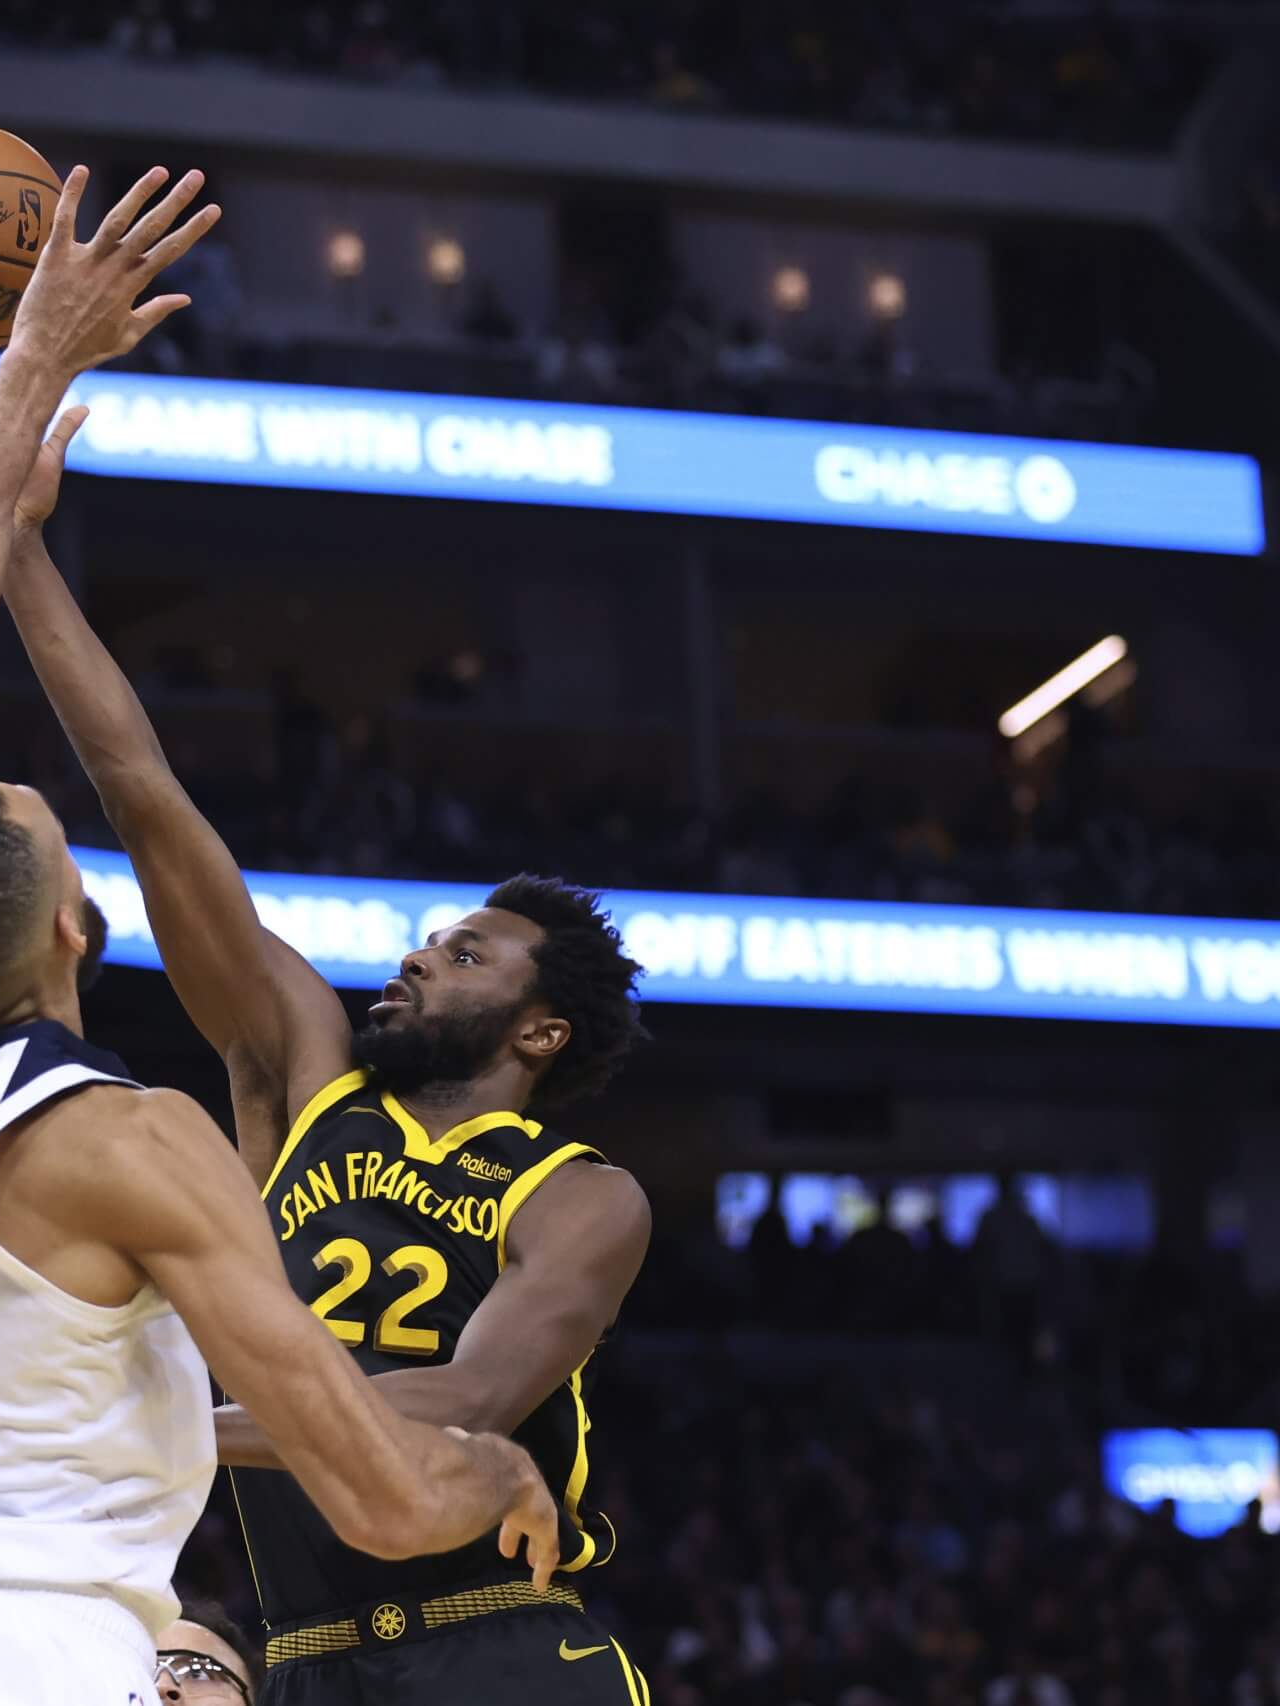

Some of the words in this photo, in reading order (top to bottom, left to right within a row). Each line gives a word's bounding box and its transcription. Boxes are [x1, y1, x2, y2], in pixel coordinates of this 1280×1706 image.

[83, 392, 259, 461] GAME
[260, 405, 422, 472] WITH
[423, 415, 613, 485] CHASE
[814, 444, 1014, 516] CHASE
[621, 911, 737, 979] OFF
[741, 917, 1004, 990] EATERIES
[1005, 929, 1189, 1000] WHEN
[280, 1160, 341, 1241] SAN
[345, 1150, 500, 1242] FRANCISCO
[455, 1151, 513, 1182] Rakuten
[308, 1237, 449, 1356] 22
